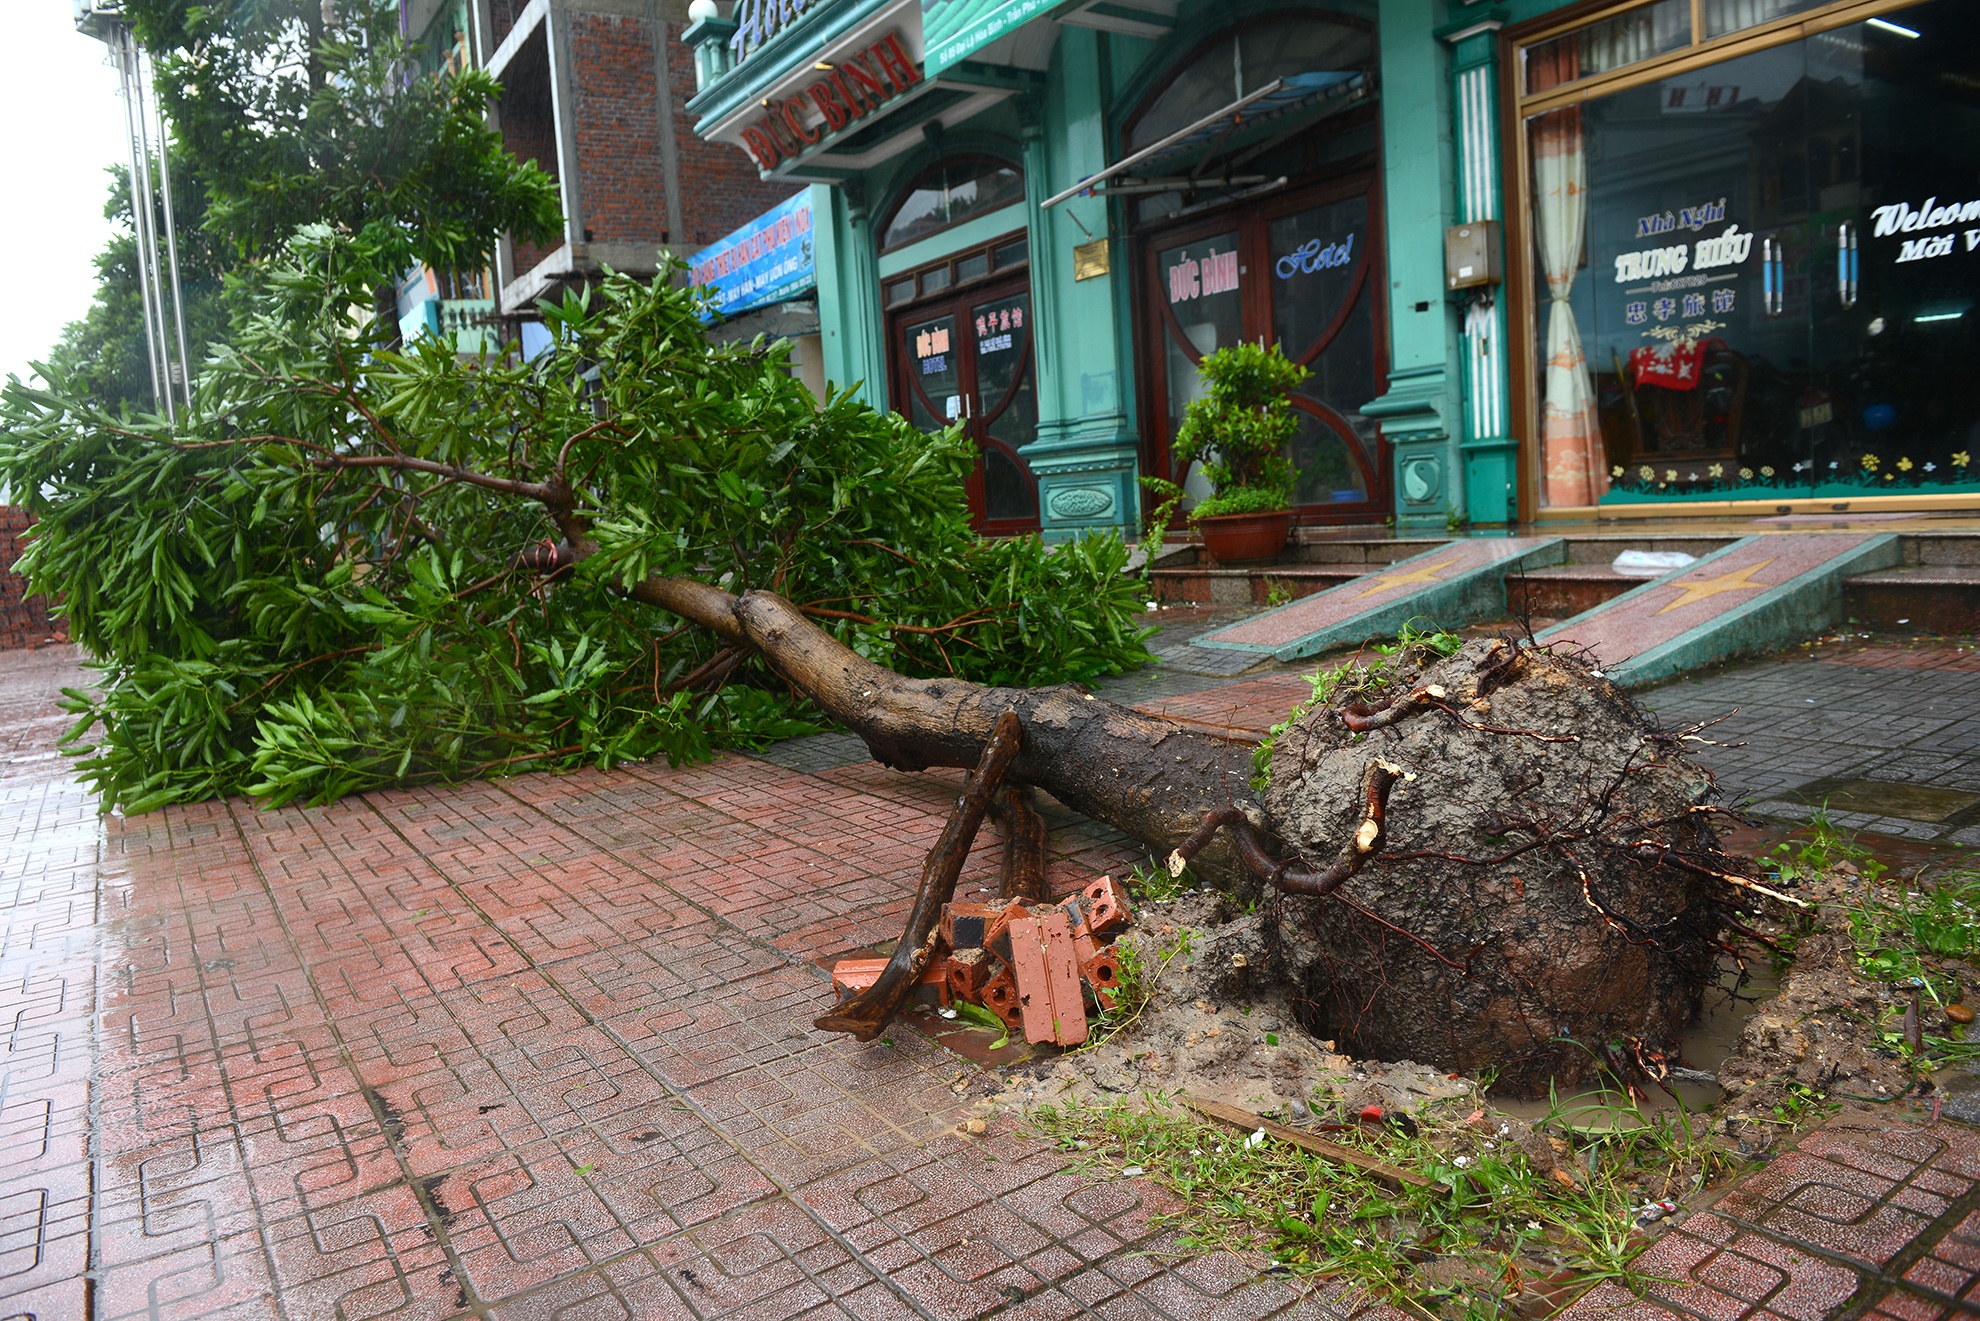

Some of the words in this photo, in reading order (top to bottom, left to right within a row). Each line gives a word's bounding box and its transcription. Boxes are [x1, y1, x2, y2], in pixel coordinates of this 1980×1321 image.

[1635, 209, 1675, 238] Nhà
[1677, 197, 1727, 232] Nghỉ
[1275, 233, 1354, 280] Hotel
[1615, 244, 1688, 283] TRUNG
[1693, 224, 1754, 270] HIẾU
[1894, 233, 1955, 263] Mời
[1201, 248, 1239, 296] BÌNH
